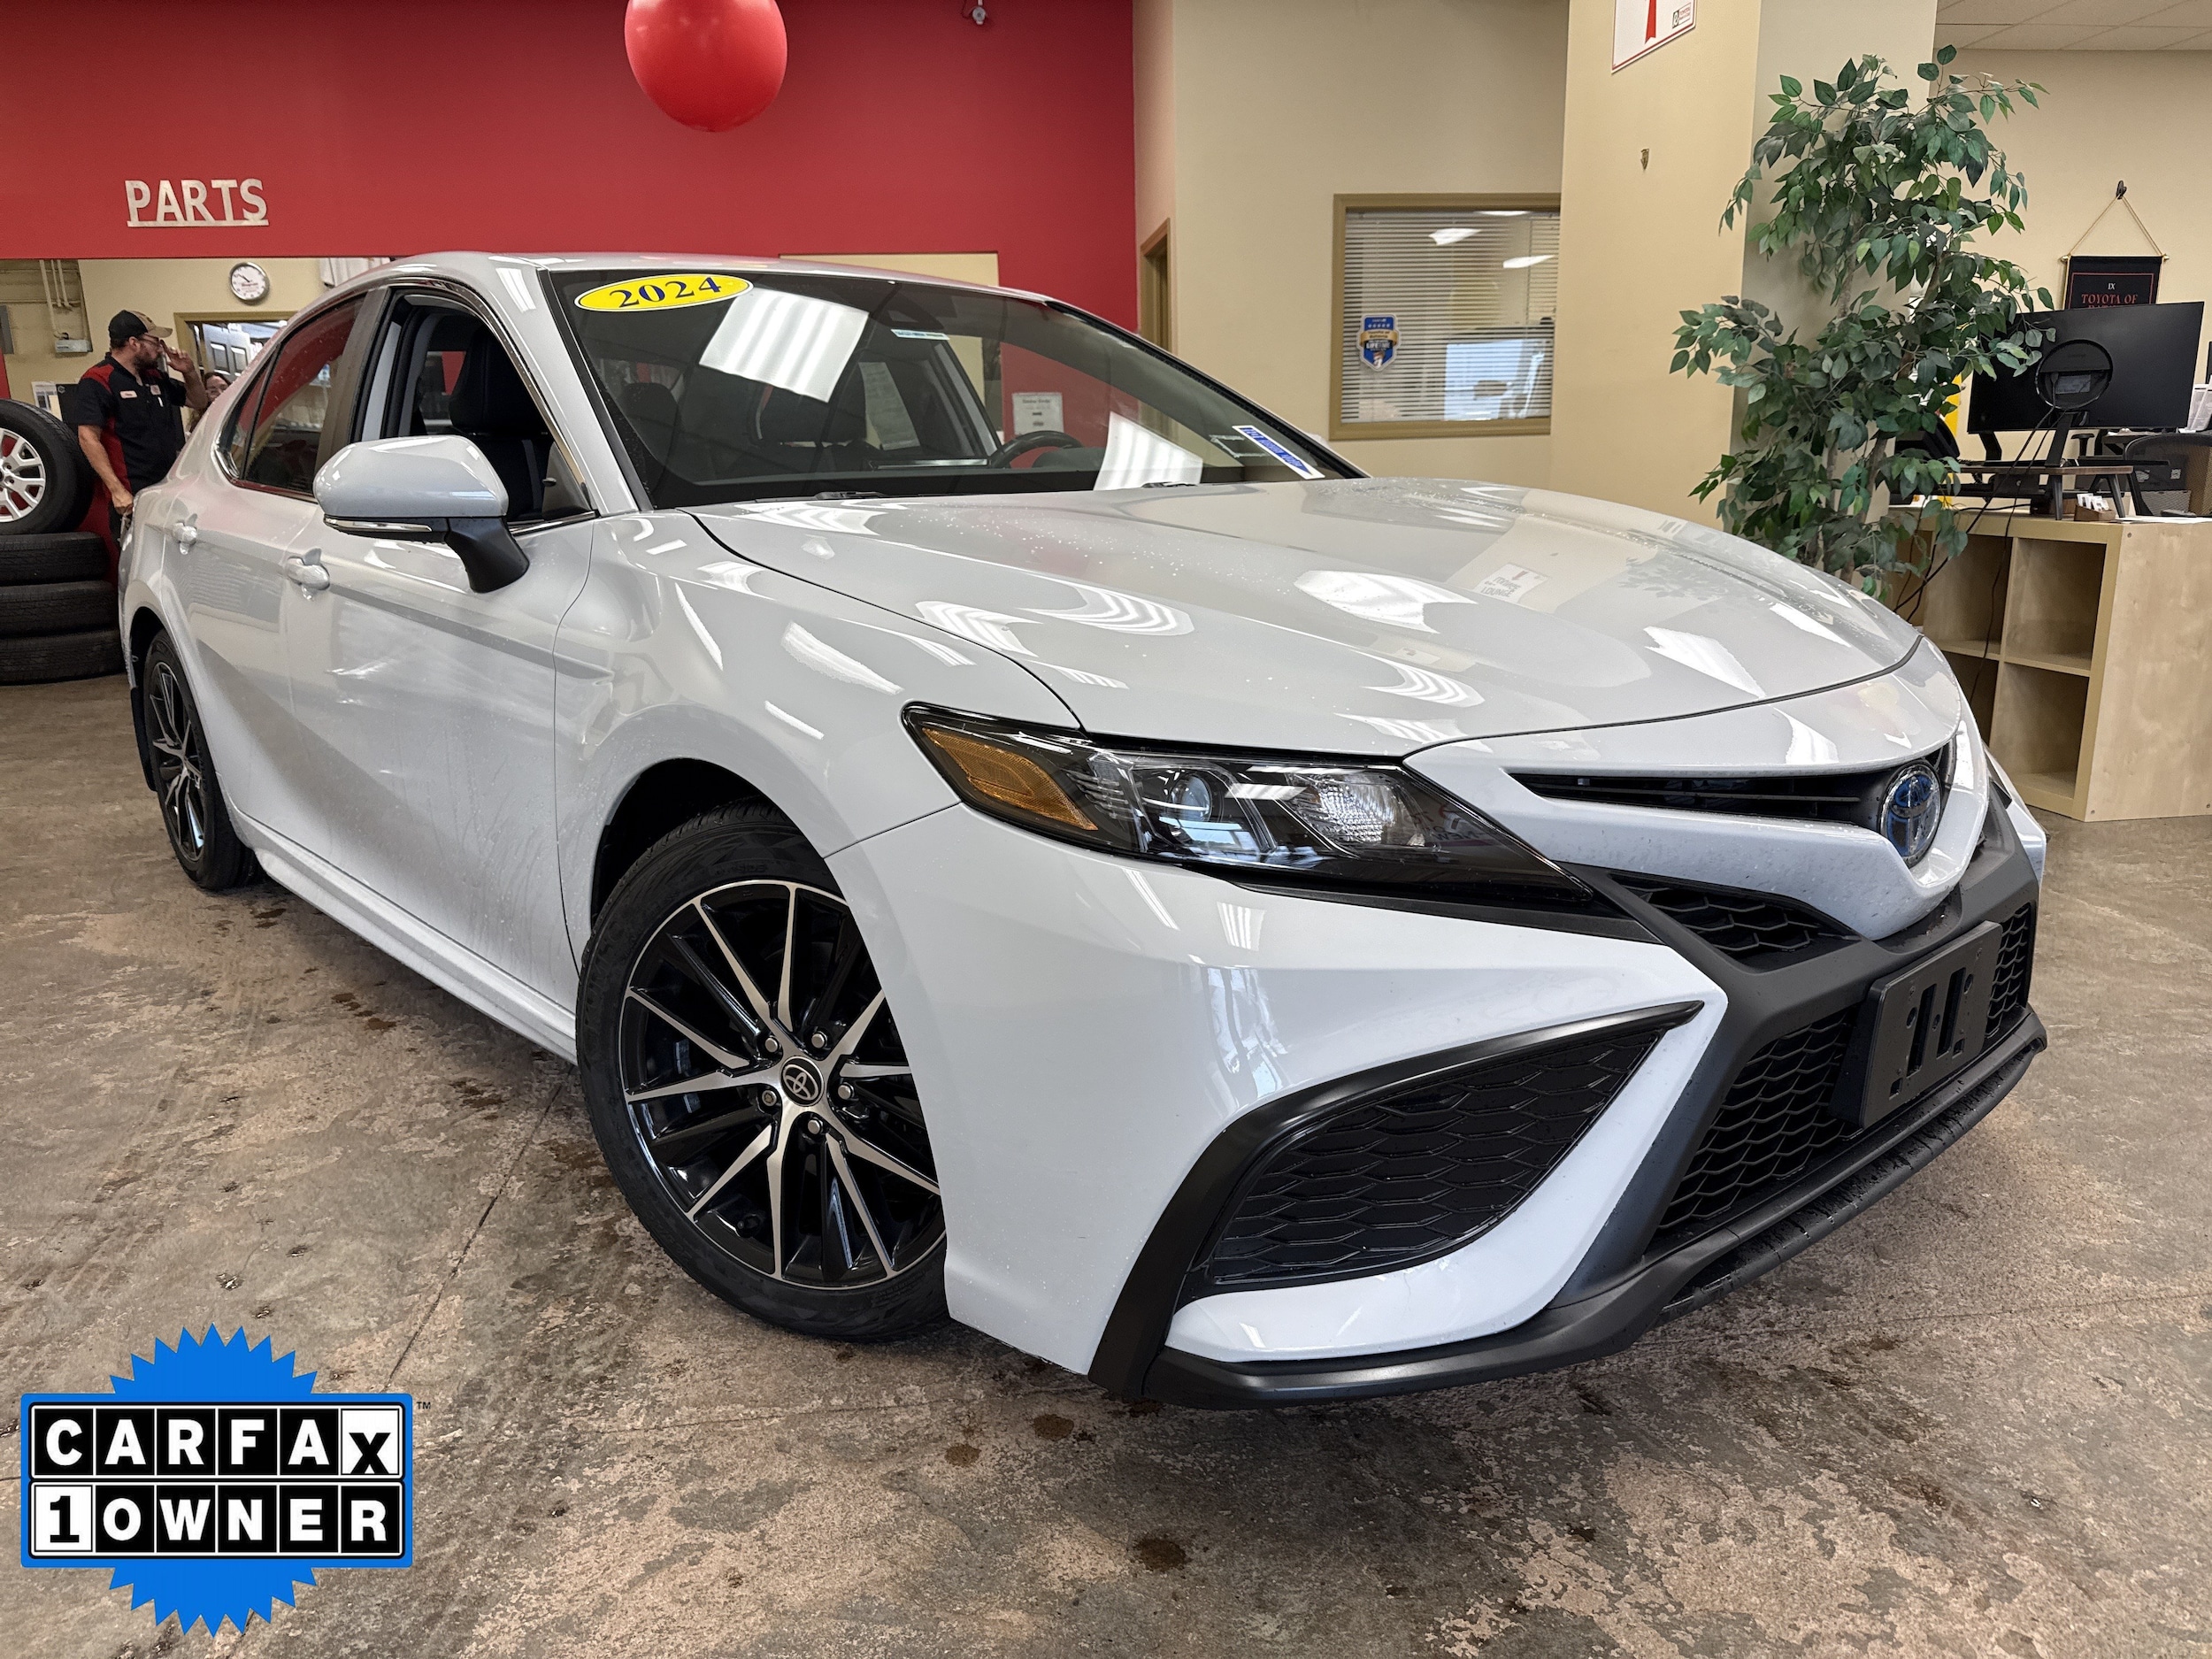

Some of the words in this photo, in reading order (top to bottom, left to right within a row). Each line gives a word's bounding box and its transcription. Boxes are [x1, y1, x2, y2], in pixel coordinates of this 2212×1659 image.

[124, 178, 268, 225] PARTS
[609, 277, 721, 308] 2024
[2081, 294, 2121, 304] TOYOTA
[2124, 294, 2138, 304] OF
